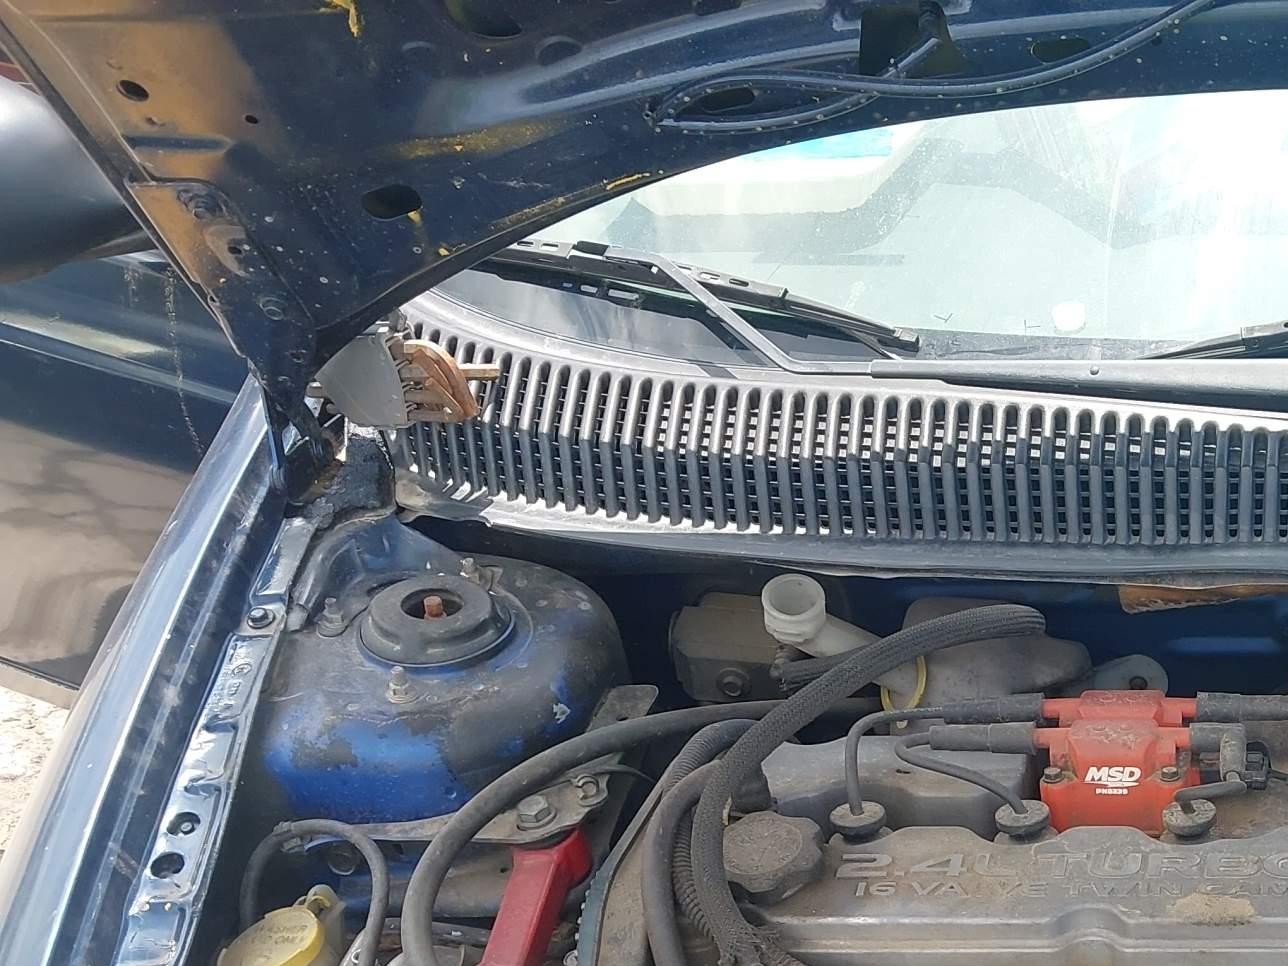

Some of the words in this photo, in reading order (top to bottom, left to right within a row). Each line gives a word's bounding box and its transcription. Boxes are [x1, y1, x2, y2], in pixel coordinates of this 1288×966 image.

[1084, 766, 1142, 782] MSD
[855, 881, 898, 897] 16
[1062, 881, 1183, 897] TWIN
